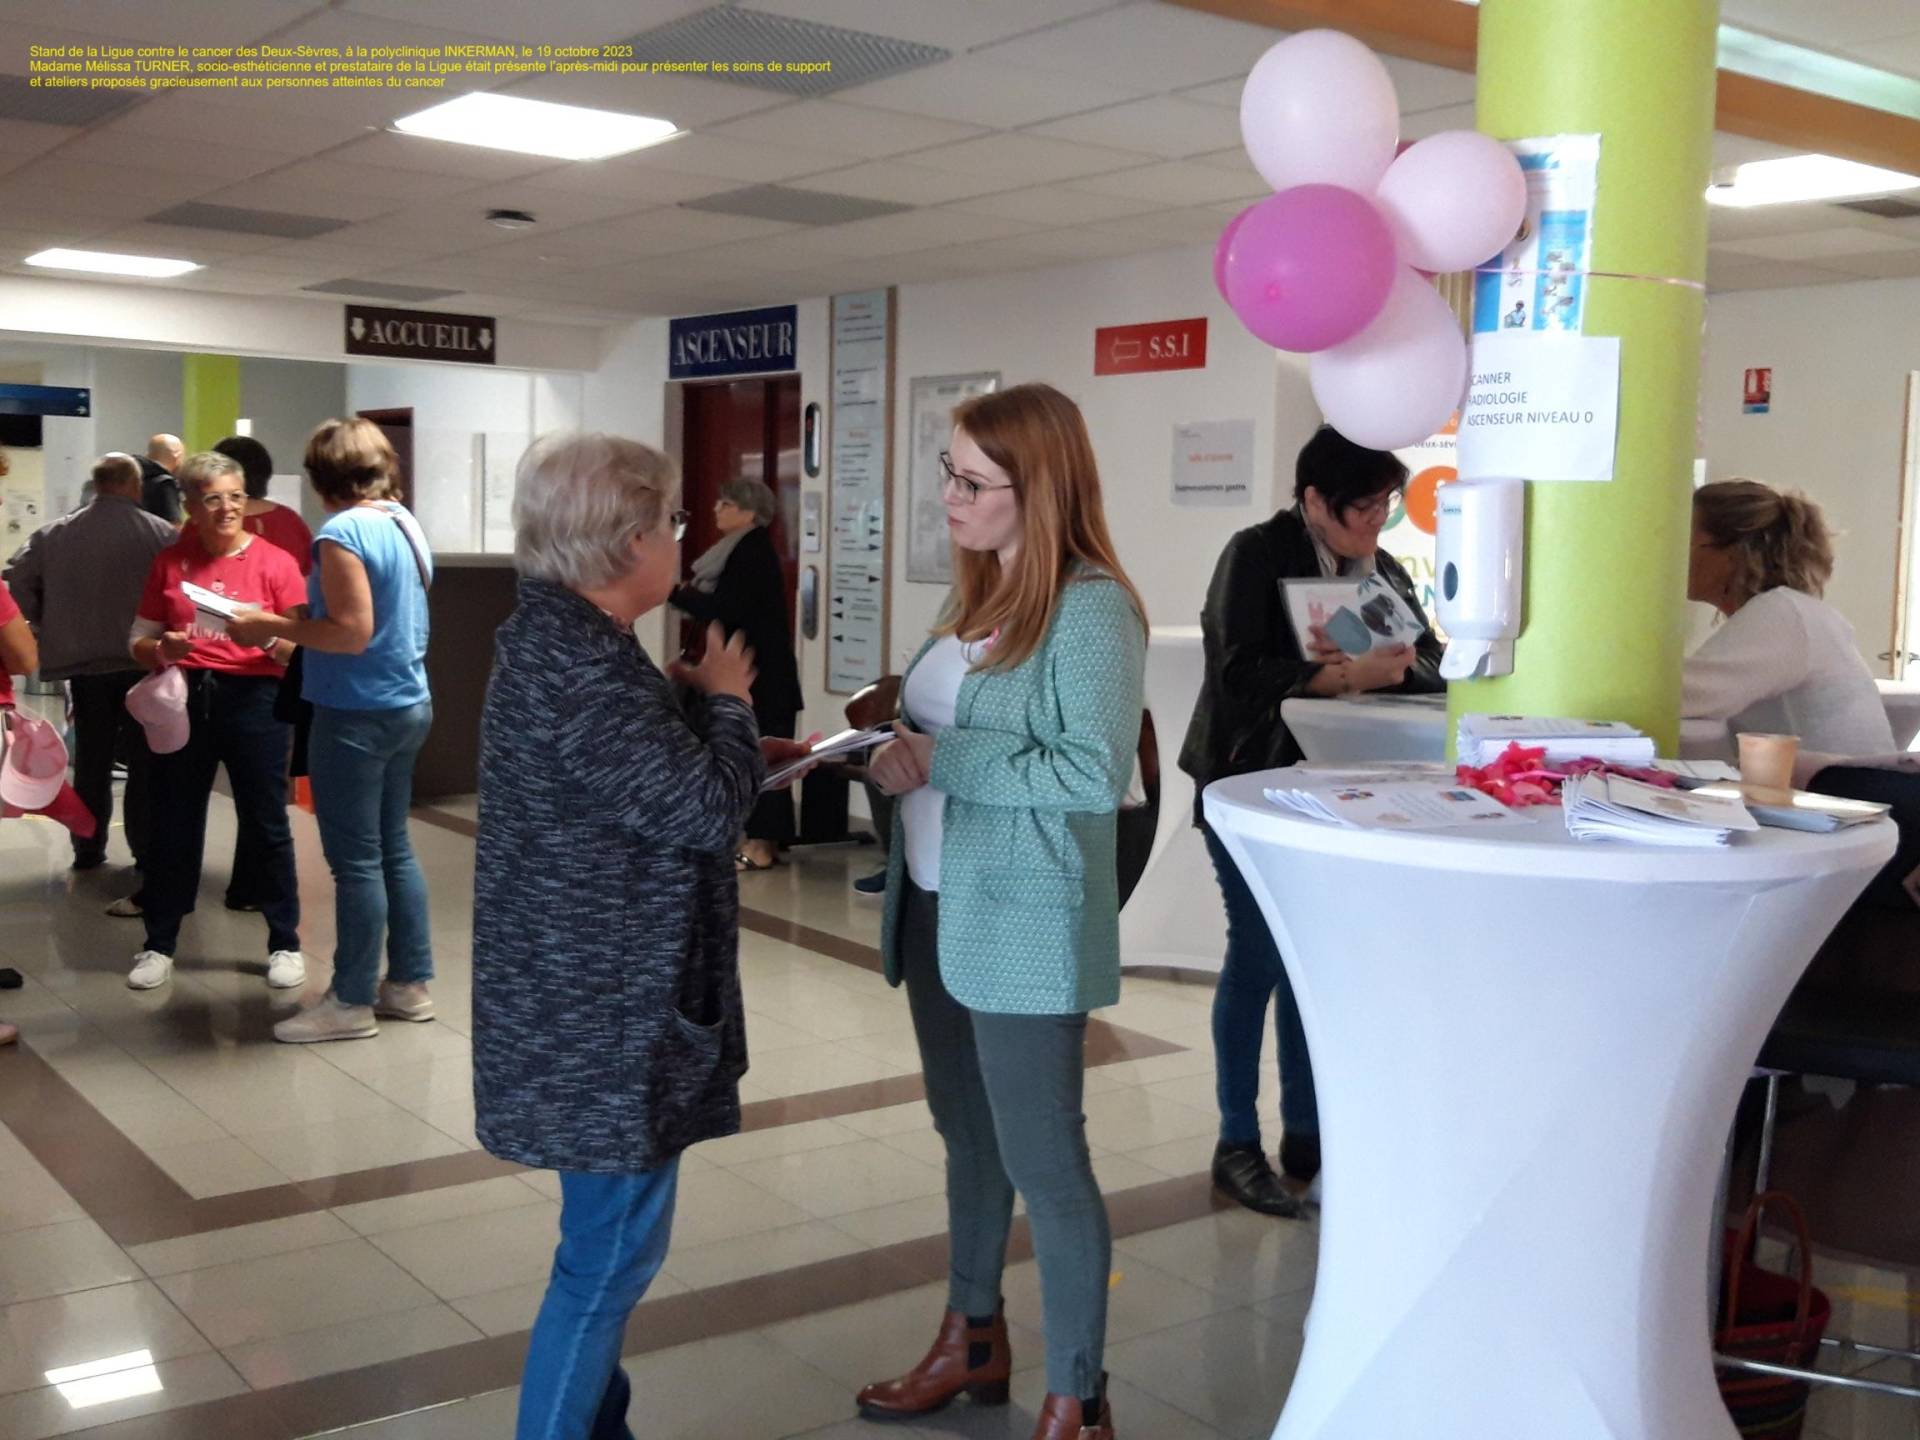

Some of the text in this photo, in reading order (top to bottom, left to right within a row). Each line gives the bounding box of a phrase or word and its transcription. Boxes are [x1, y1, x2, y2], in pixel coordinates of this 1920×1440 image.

[368, 320, 478, 351] ACCUEIL
[674, 322, 792, 365] ASCENSEUR
[1149, 333, 1190, 360] S.S.I
[1470, 372, 1511, 386] CANNER
[1526, 411, 1580, 424] NIVEAU
